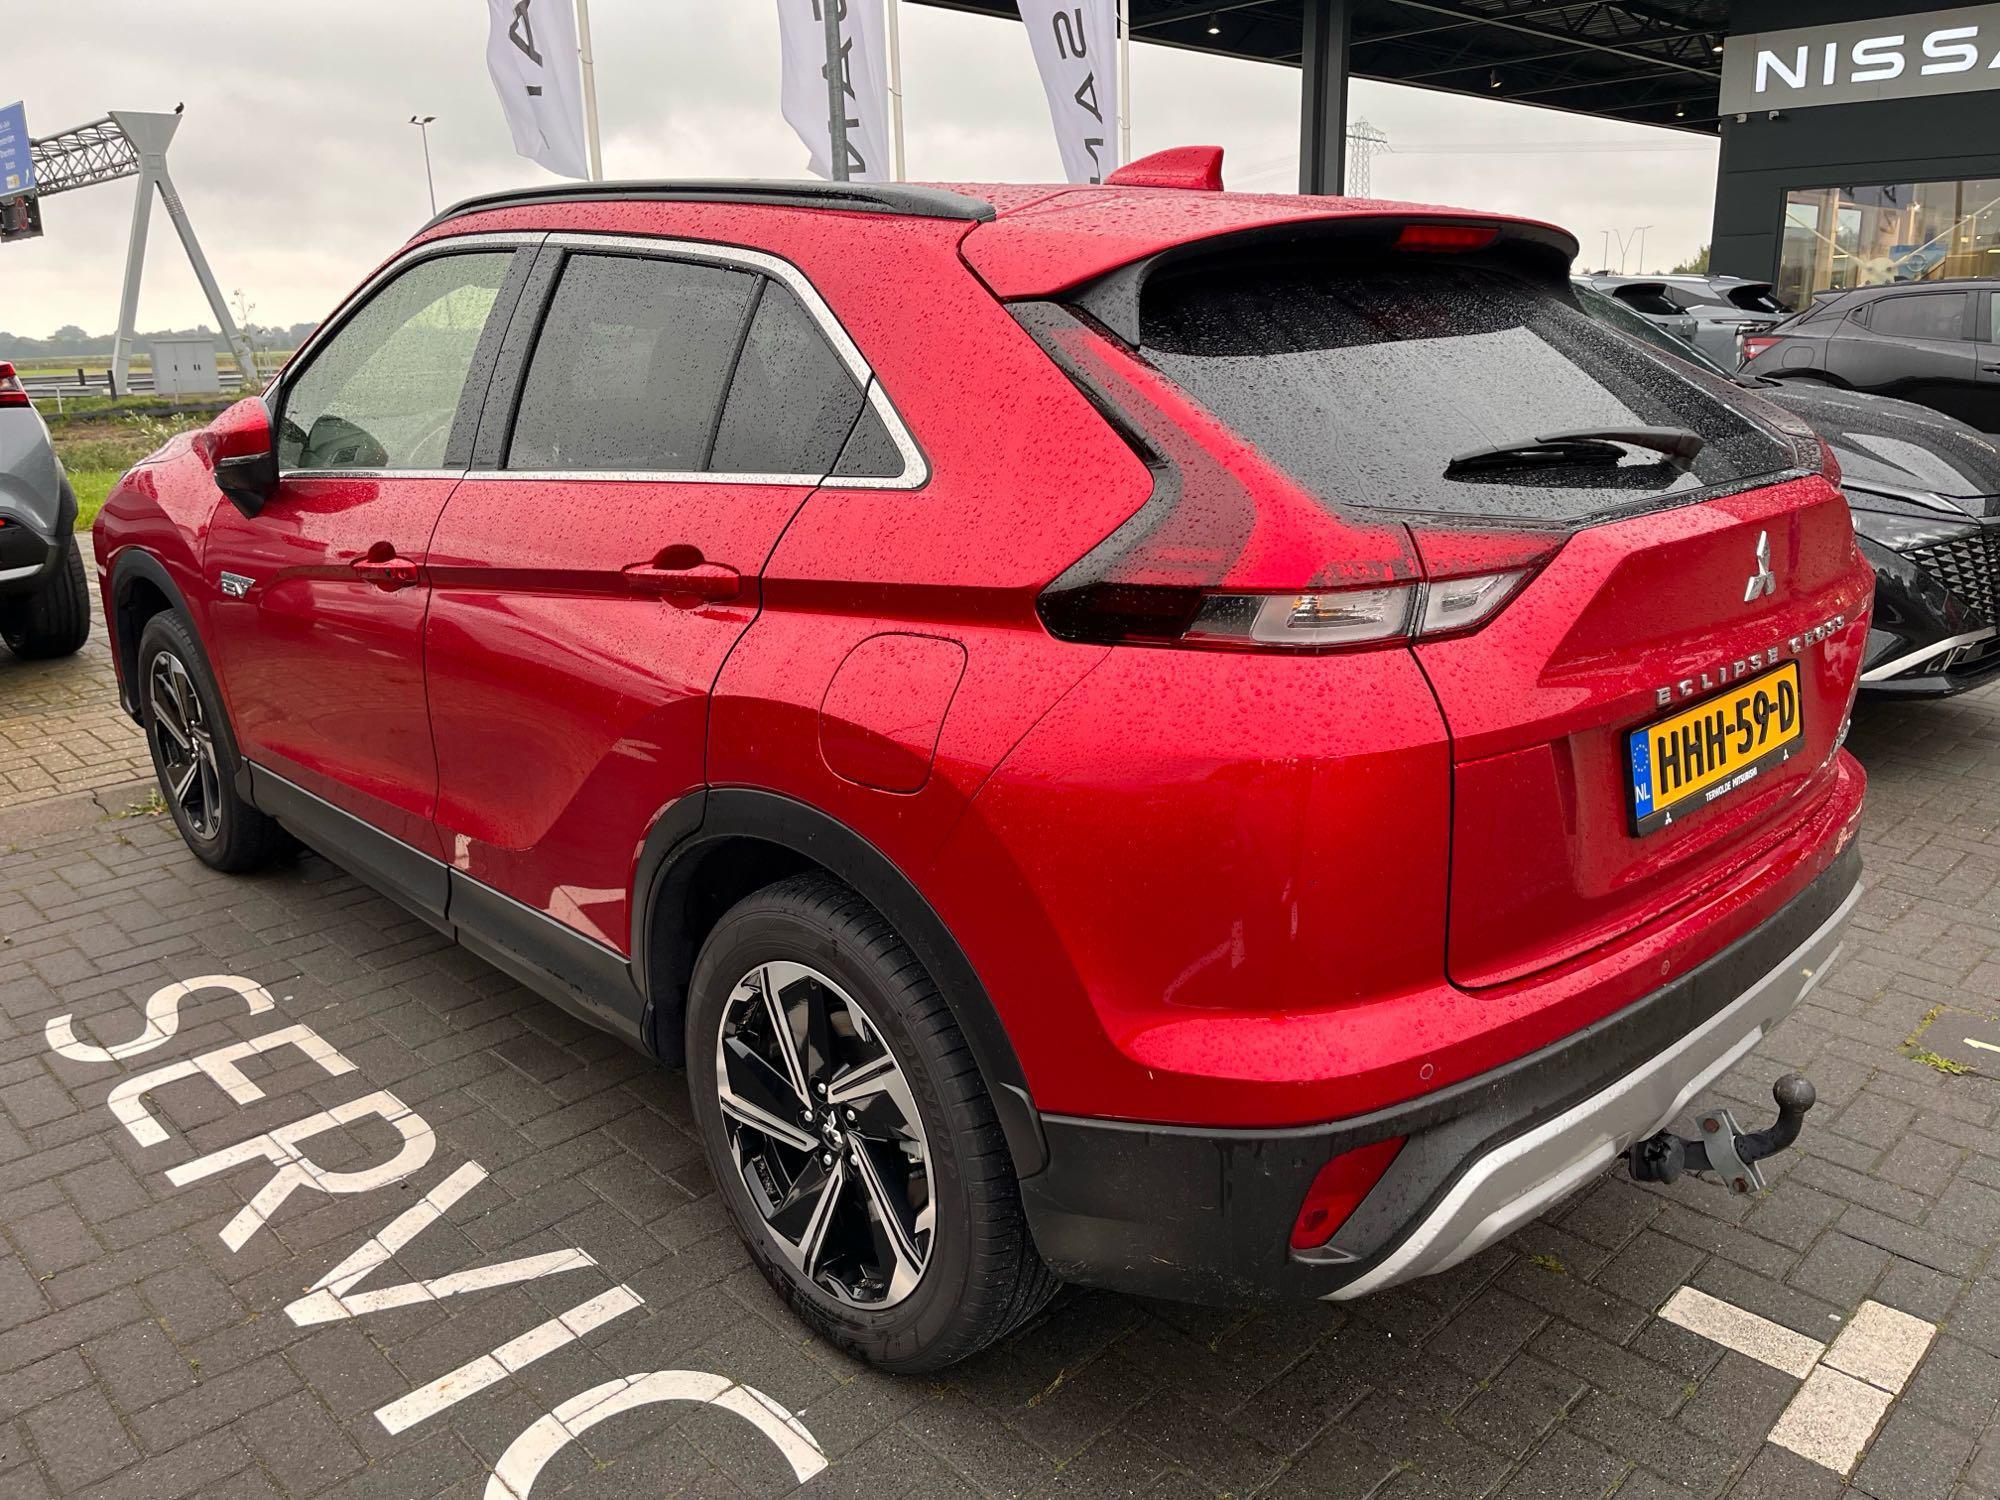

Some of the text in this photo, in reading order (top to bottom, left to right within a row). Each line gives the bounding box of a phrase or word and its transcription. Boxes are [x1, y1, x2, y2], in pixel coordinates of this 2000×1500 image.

[1754, 25, 2000, 94] NISS
[1656, 614, 1845, 706] ECLIPSE CROSS
[1635, 679, 1795, 804] NL HHH-59-D
[1705, 766, 1758, 802] TERWOLDE MITSUBISHI
[45, 974, 830, 1500] SERVIC
